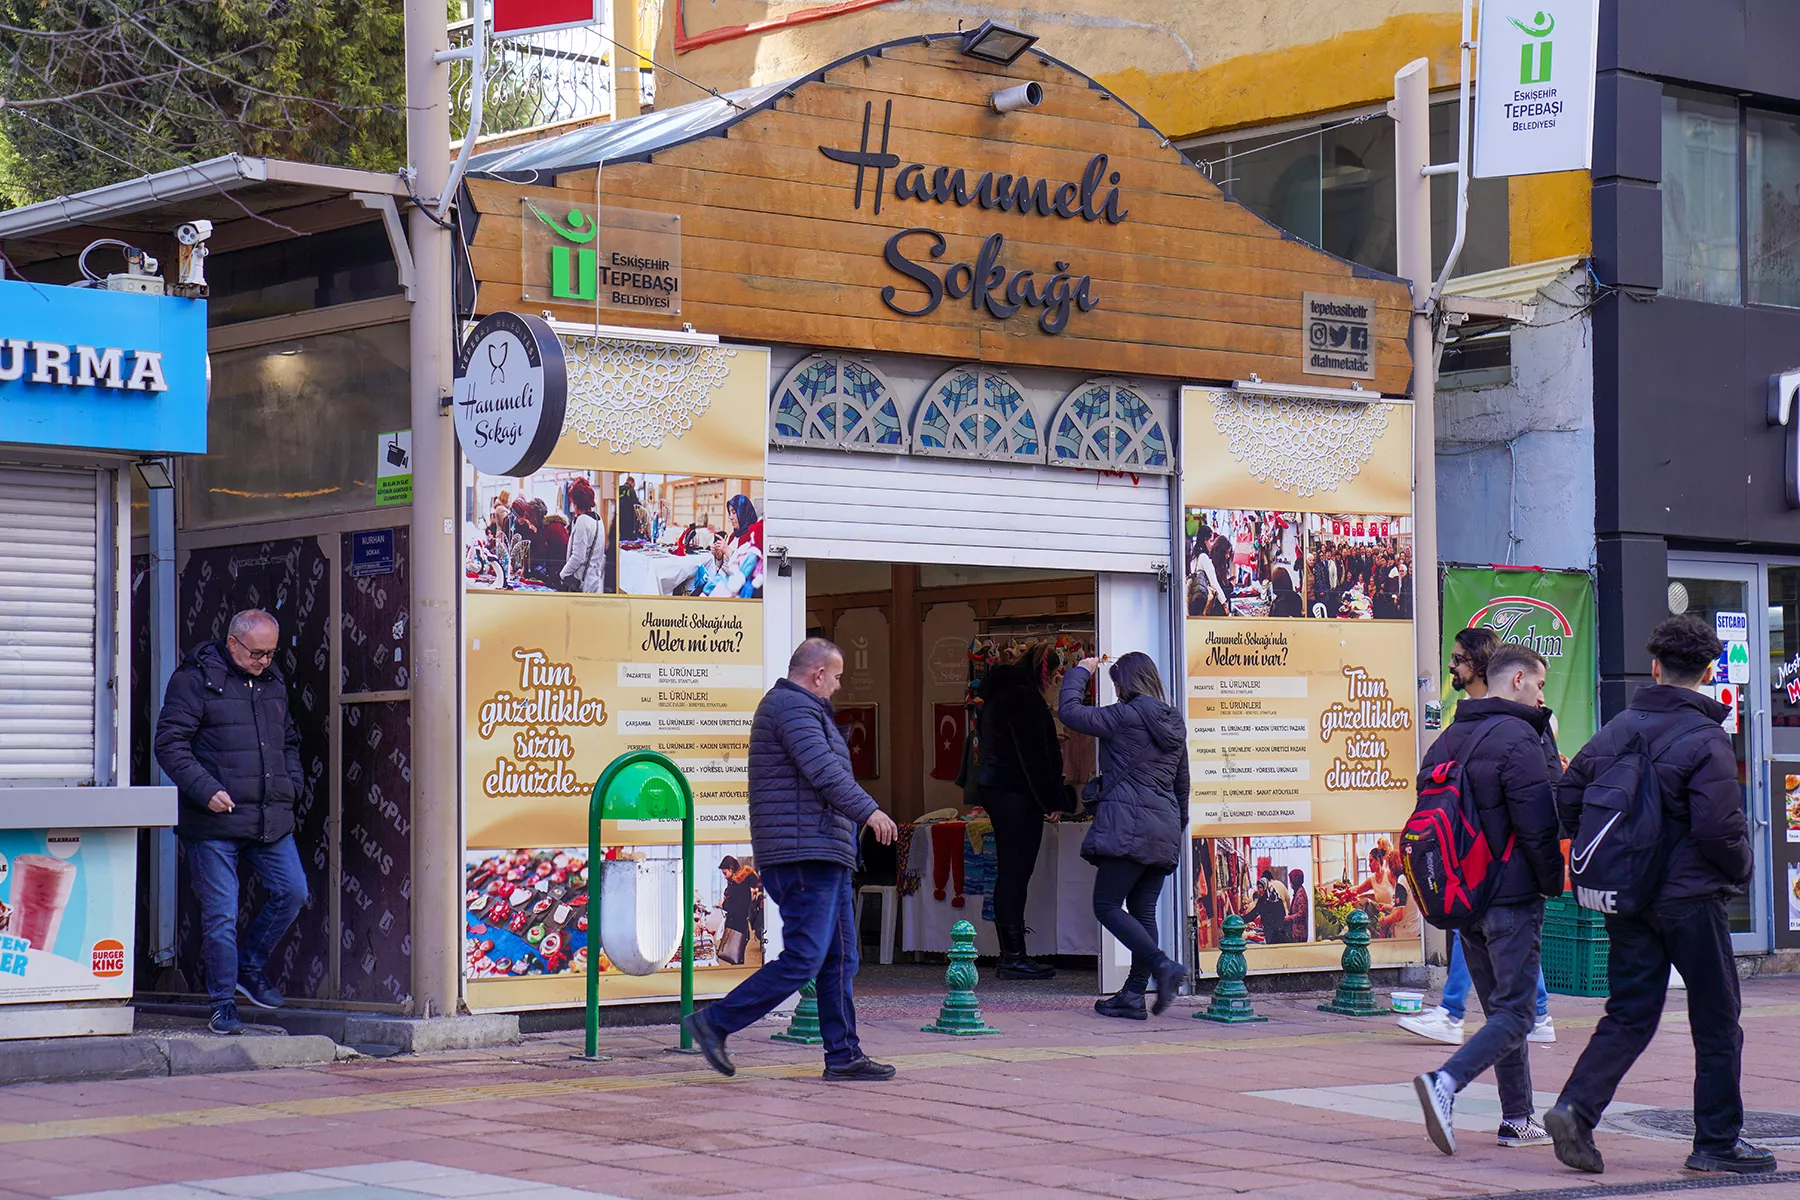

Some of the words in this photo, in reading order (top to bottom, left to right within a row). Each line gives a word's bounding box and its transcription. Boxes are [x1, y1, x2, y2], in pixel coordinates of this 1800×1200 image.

[1514, 87, 1557, 101] ESKİŞEHİR
[1504, 101, 1562, 118] TEPEBAŞI
[1513, 118, 1555, 131] BELEDİYESİ
[612, 252, 669, 271] ESKİŞEHİR
[599, 266, 678, 295] TEPEBAŞI
[882, 228, 1099, 334] Sokağı
[612, 291, 670, 308] BELEDİYESİ
[1718, 616, 1745, 628] SETCARD
[642, 630, 686, 652] Neler
[688, 634, 708, 652] mi
[710, 631, 743, 652] var?
[1206, 646, 1241, 666] Neler
[1243, 650, 1260, 666] mi
[1261, 647, 1288, 666] var?
[515, 650, 573, 687] Tüm
[658, 669, 668, 677] EL
[670, 667, 709, 678] ÜRÜNLERİ
[1344, 668, 1387, 700] Tüm
[658, 692, 668, 700] EL
[670, 690, 709, 701] ÜRÜNLERİ
[482, 689, 605, 736] güzellikler
[1322, 701, 1411, 740] güzellikler
[516, 730, 572, 758] sizin
[1347, 734, 1388, 758] sizin
[1327, 760, 1407, 788] elinizde...
[1577, 885, 1618, 914] NIKE
[92, 951, 124, 959] BURGER
[93, 959, 124, 971] KING
